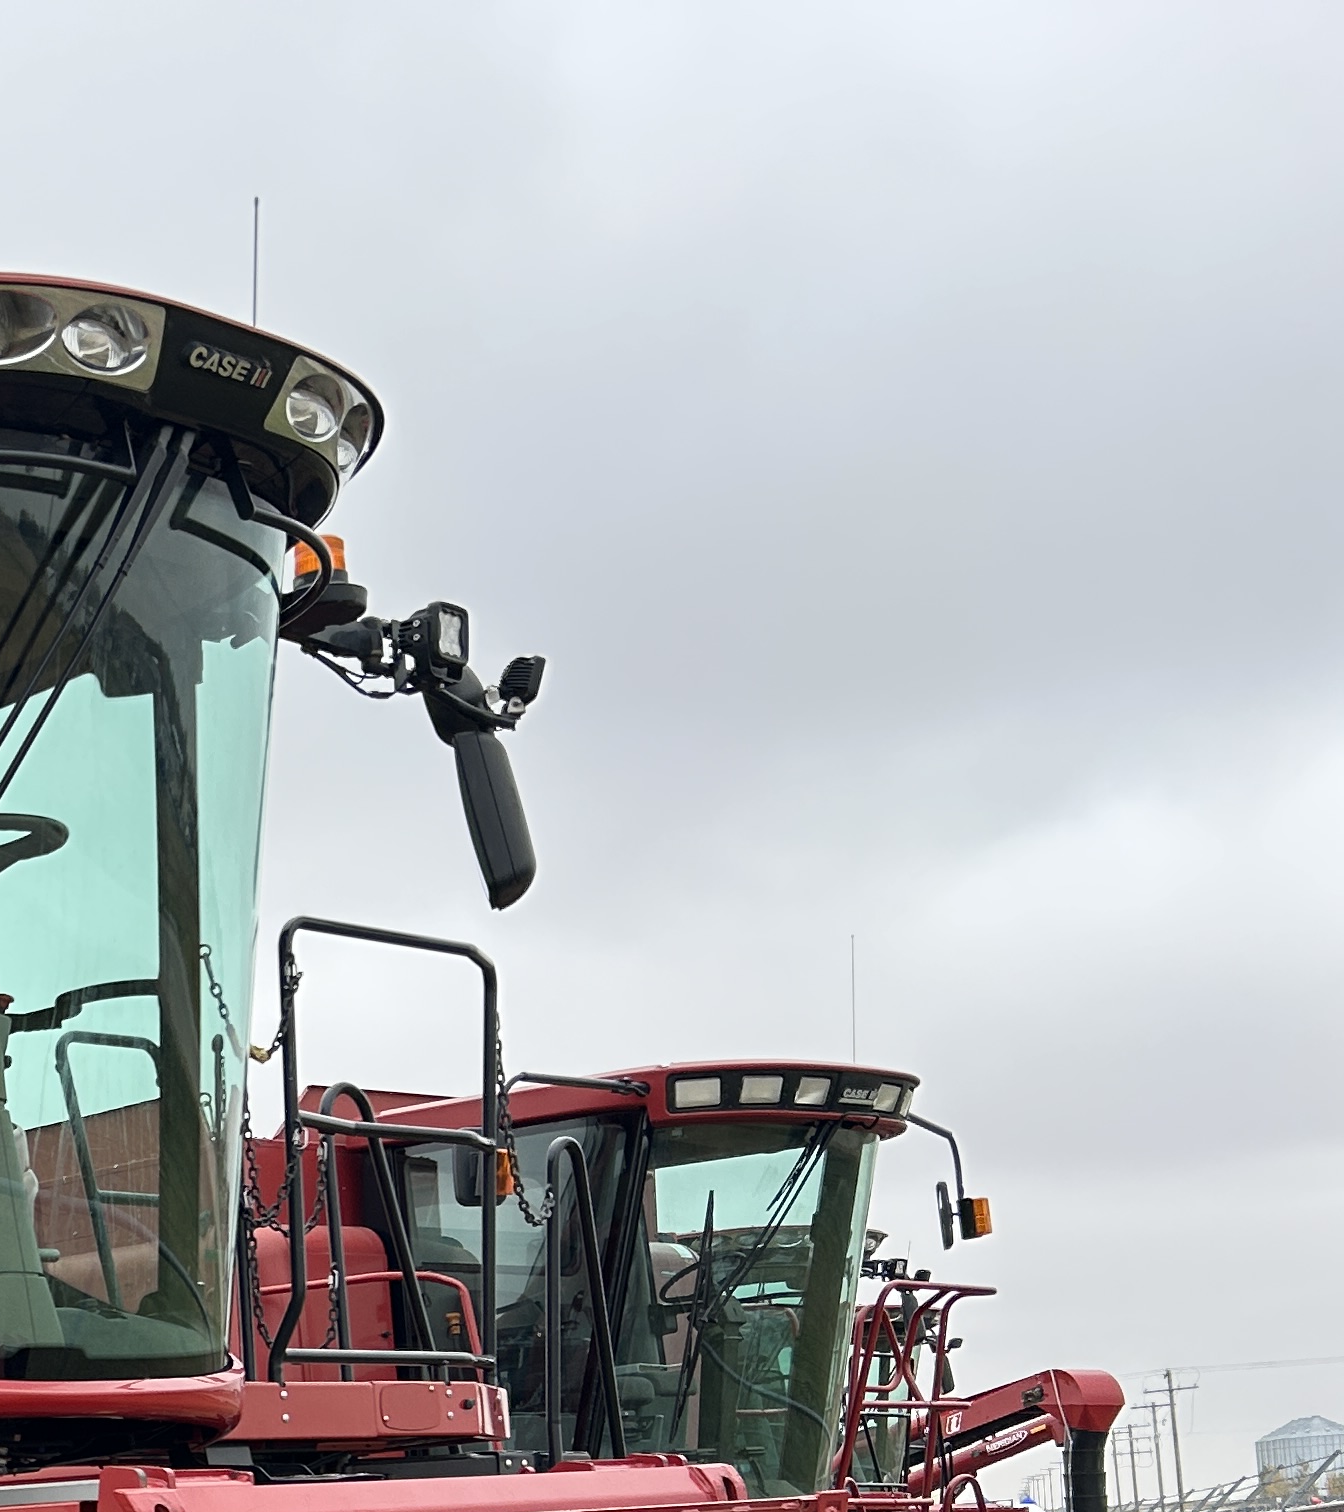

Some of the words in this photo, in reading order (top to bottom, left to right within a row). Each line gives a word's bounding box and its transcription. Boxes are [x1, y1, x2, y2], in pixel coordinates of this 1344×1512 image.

[189, 346, 251, 382] CASE
[842, 1088, 870, 1099] CASE
[985, 1430, 1026, 1454] MERIDIAN
